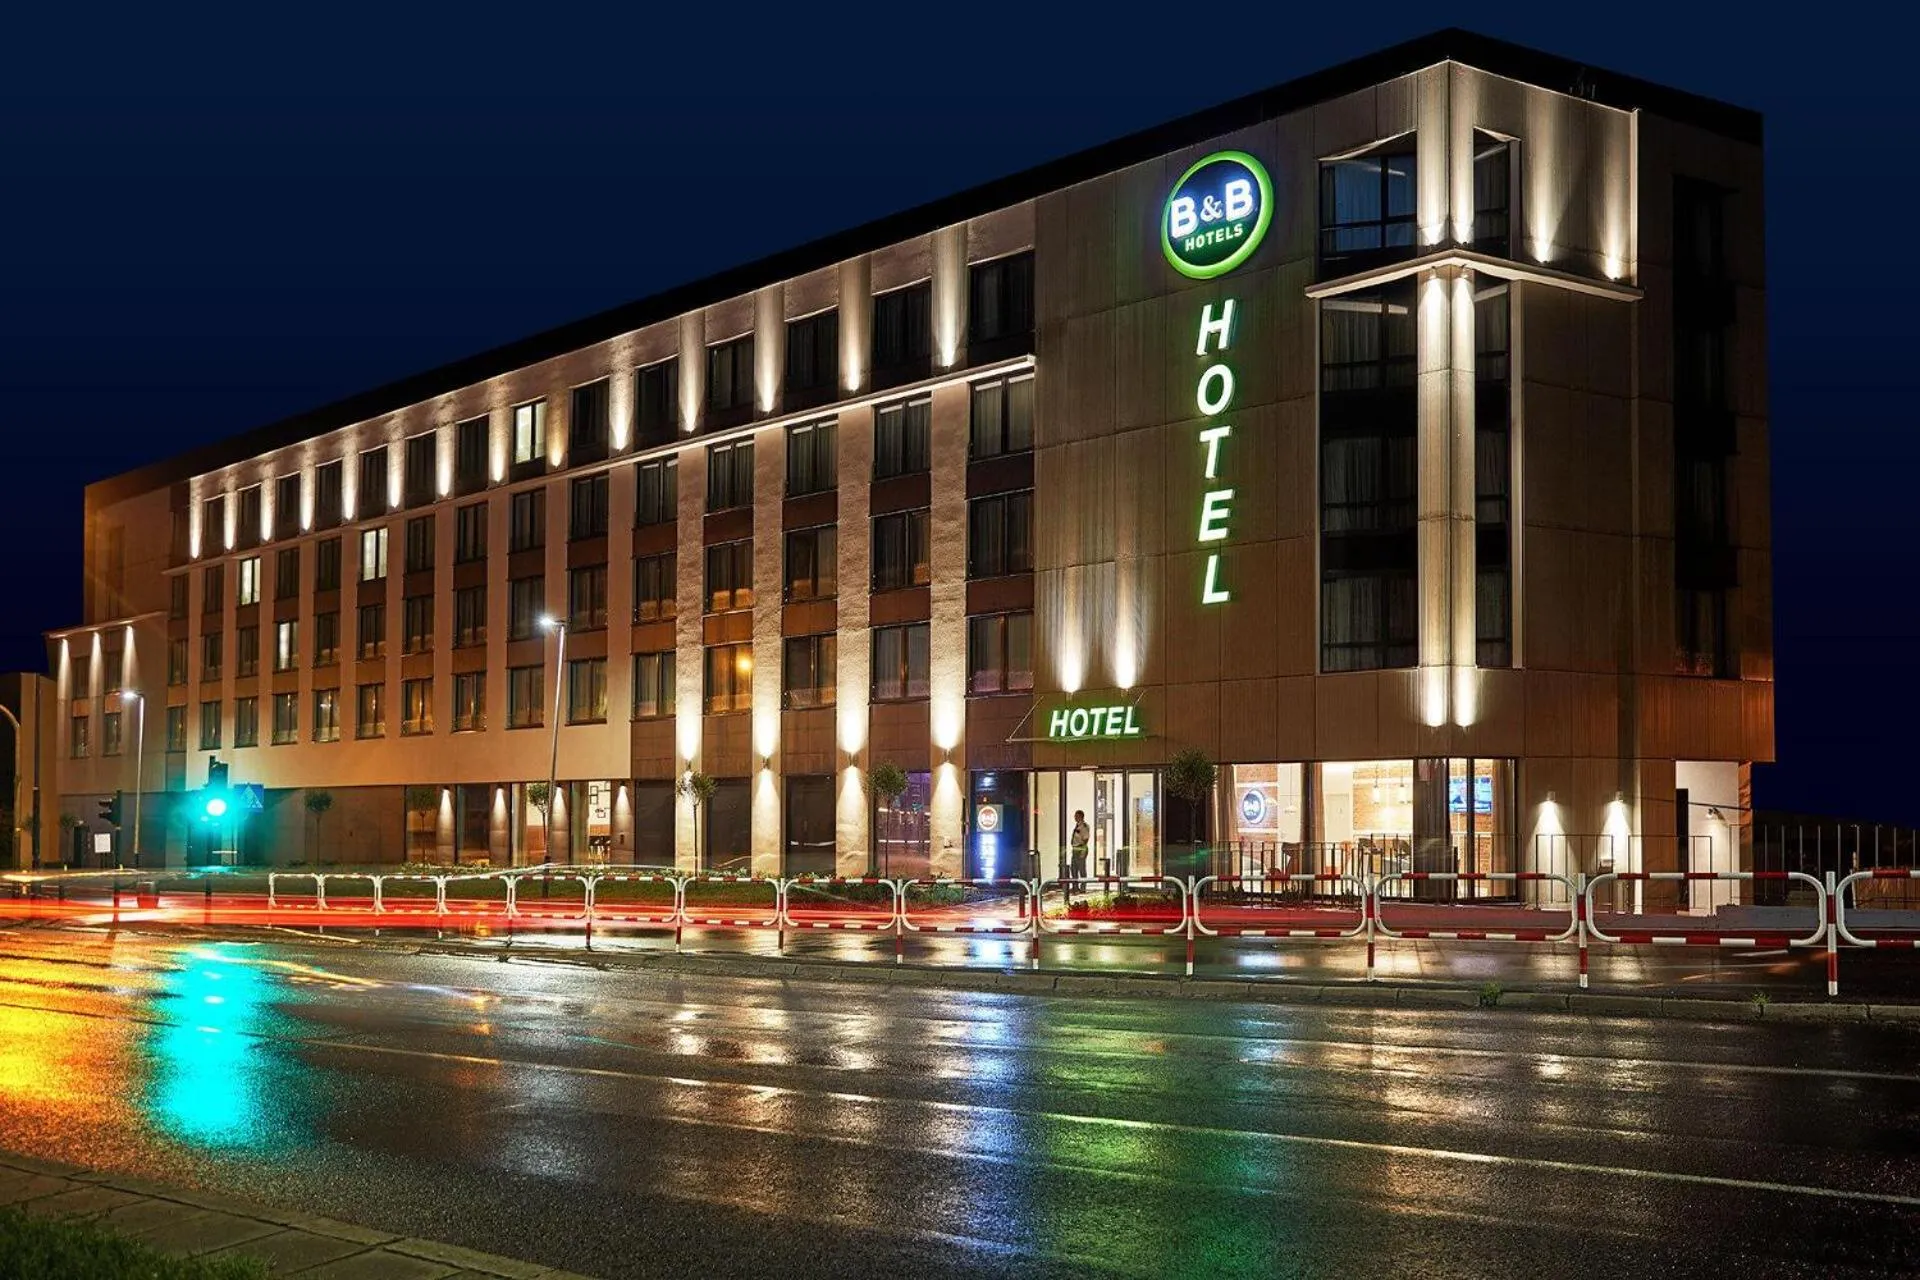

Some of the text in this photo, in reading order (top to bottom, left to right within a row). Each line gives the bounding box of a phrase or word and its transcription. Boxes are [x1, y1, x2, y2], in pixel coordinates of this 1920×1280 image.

[1171, 178, 1254, 239] B&B
[1184, 223, 1244, 252] HOTELS
[1196, 298, 1235, 604] HOTEL
[1049, 706, 1140, 737] HOTEL
